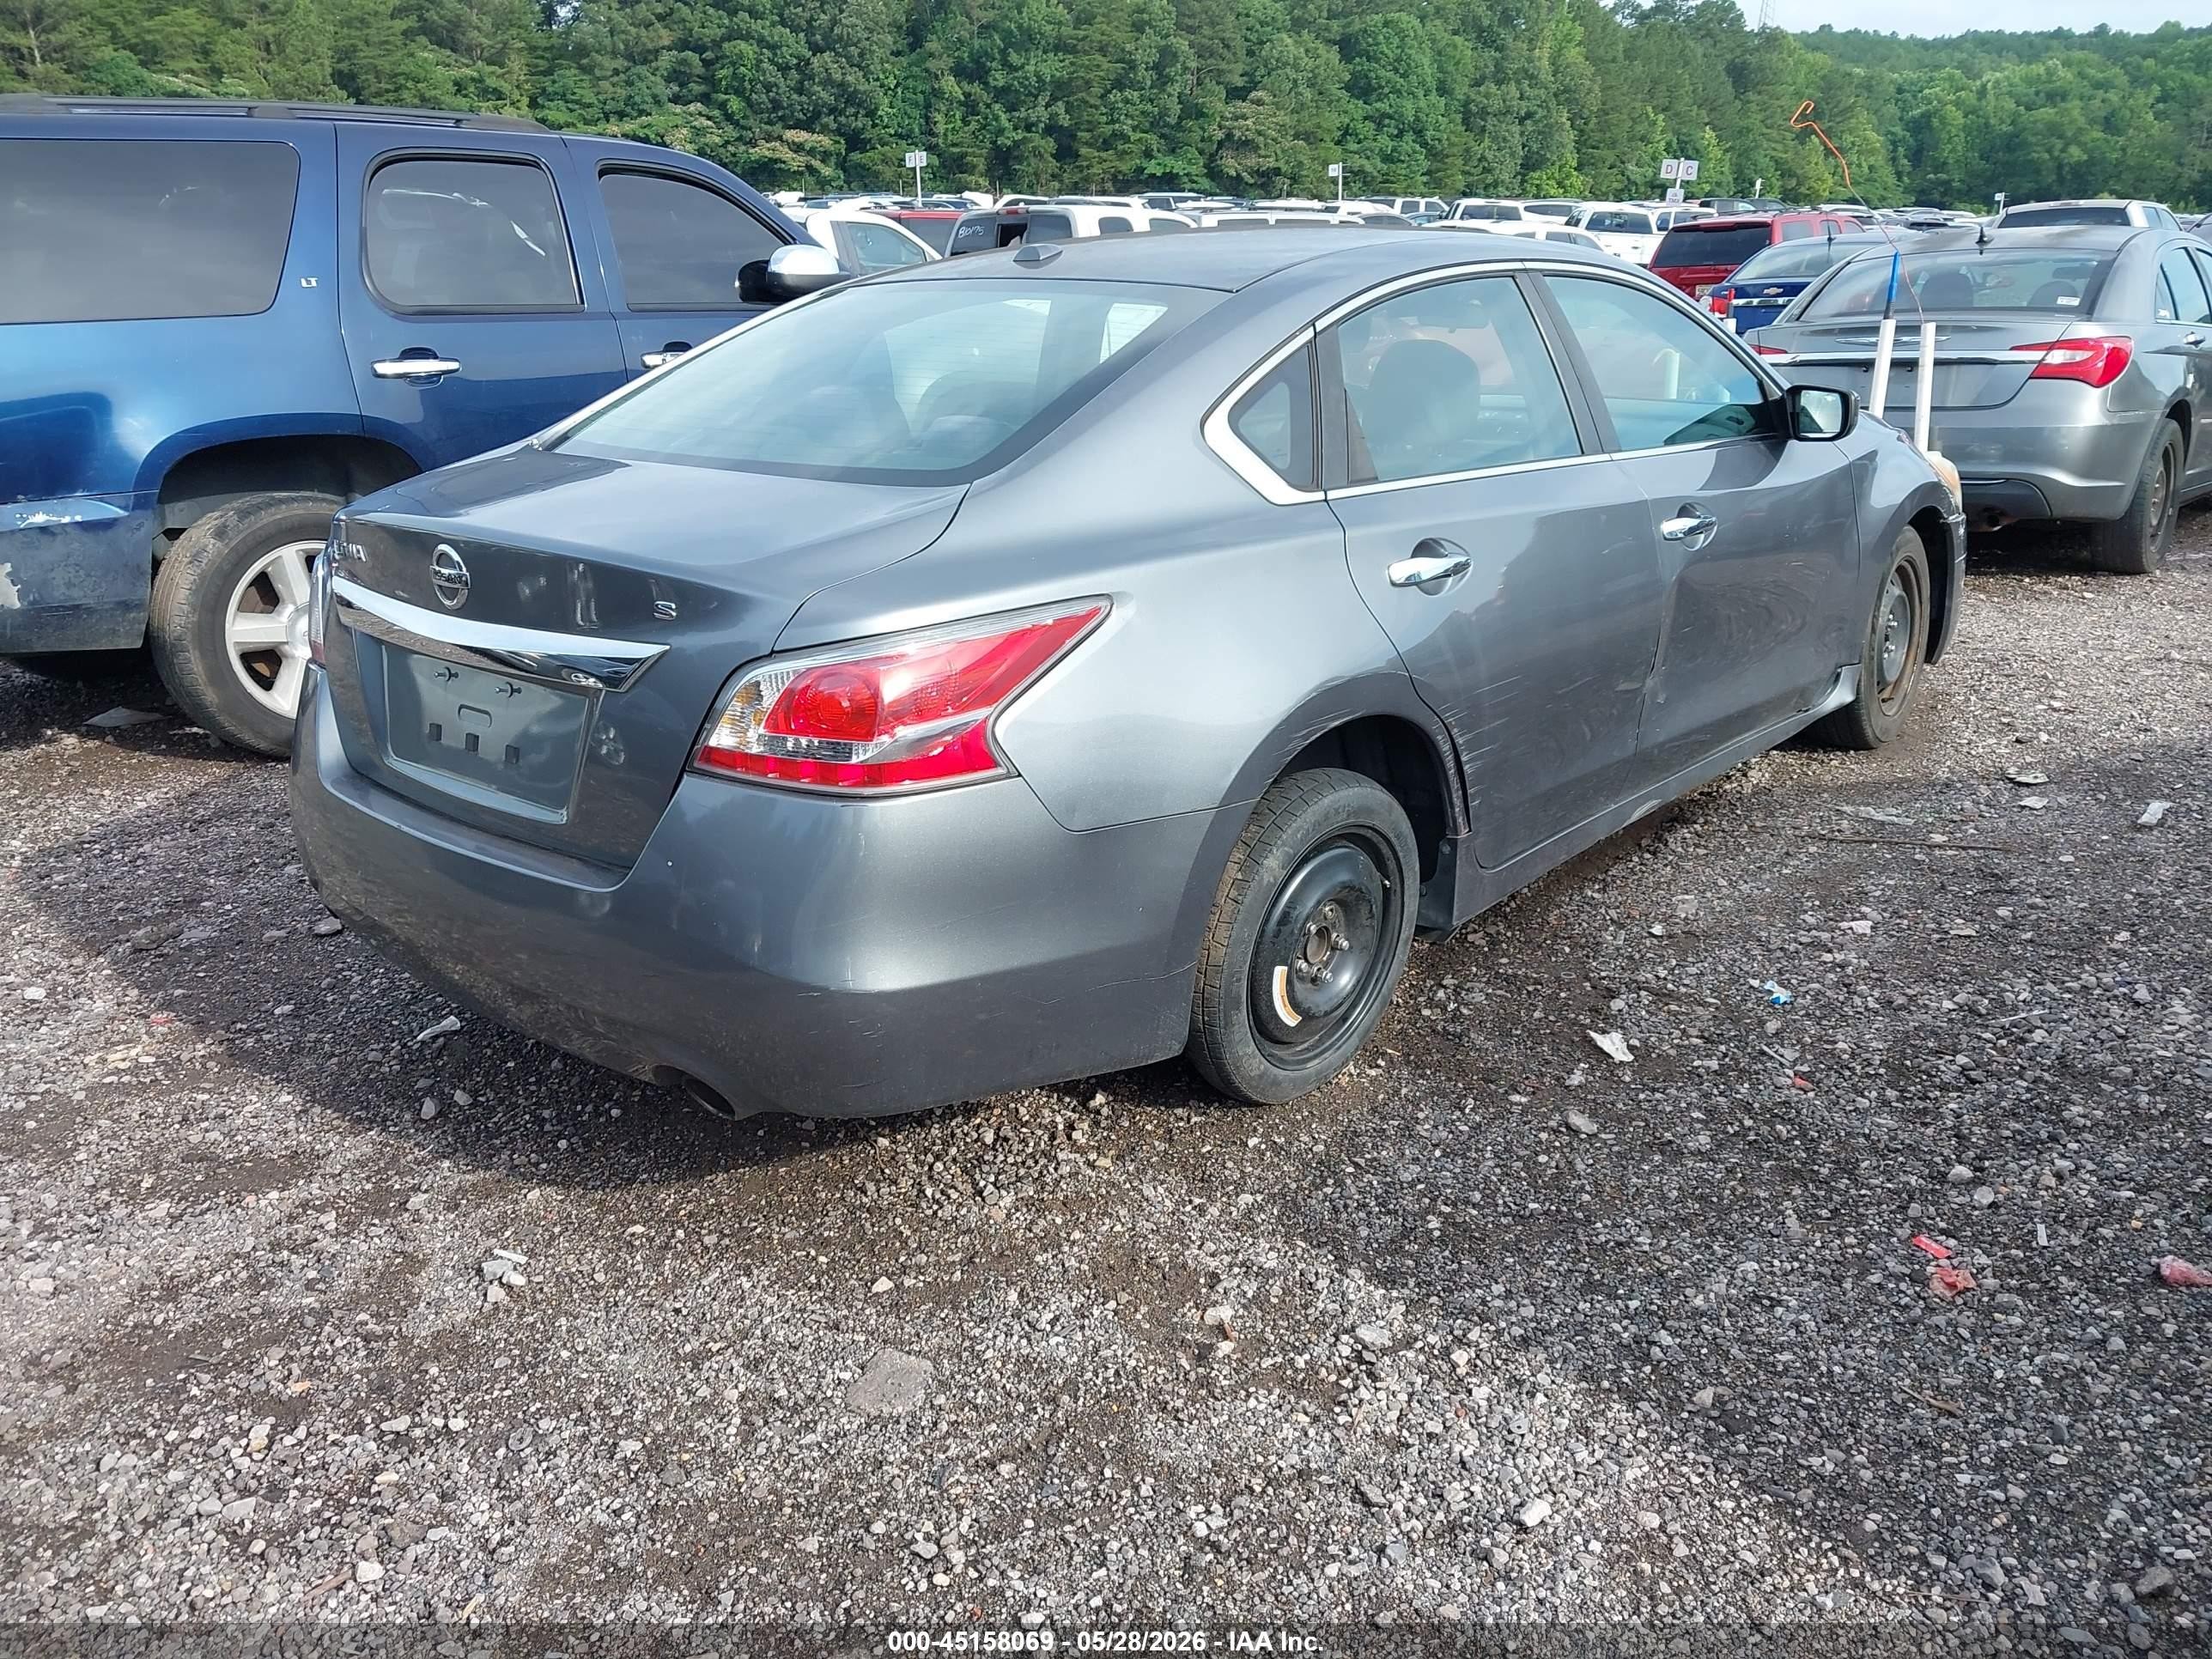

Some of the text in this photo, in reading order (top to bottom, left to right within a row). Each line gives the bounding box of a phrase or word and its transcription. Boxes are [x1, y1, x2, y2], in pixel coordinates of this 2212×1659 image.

[1665, 164, 1674, 174] D
[1686, 165, 1693, 176] C
[301, 277, 318, 288] LT
[653, 601, 677, 621] S
